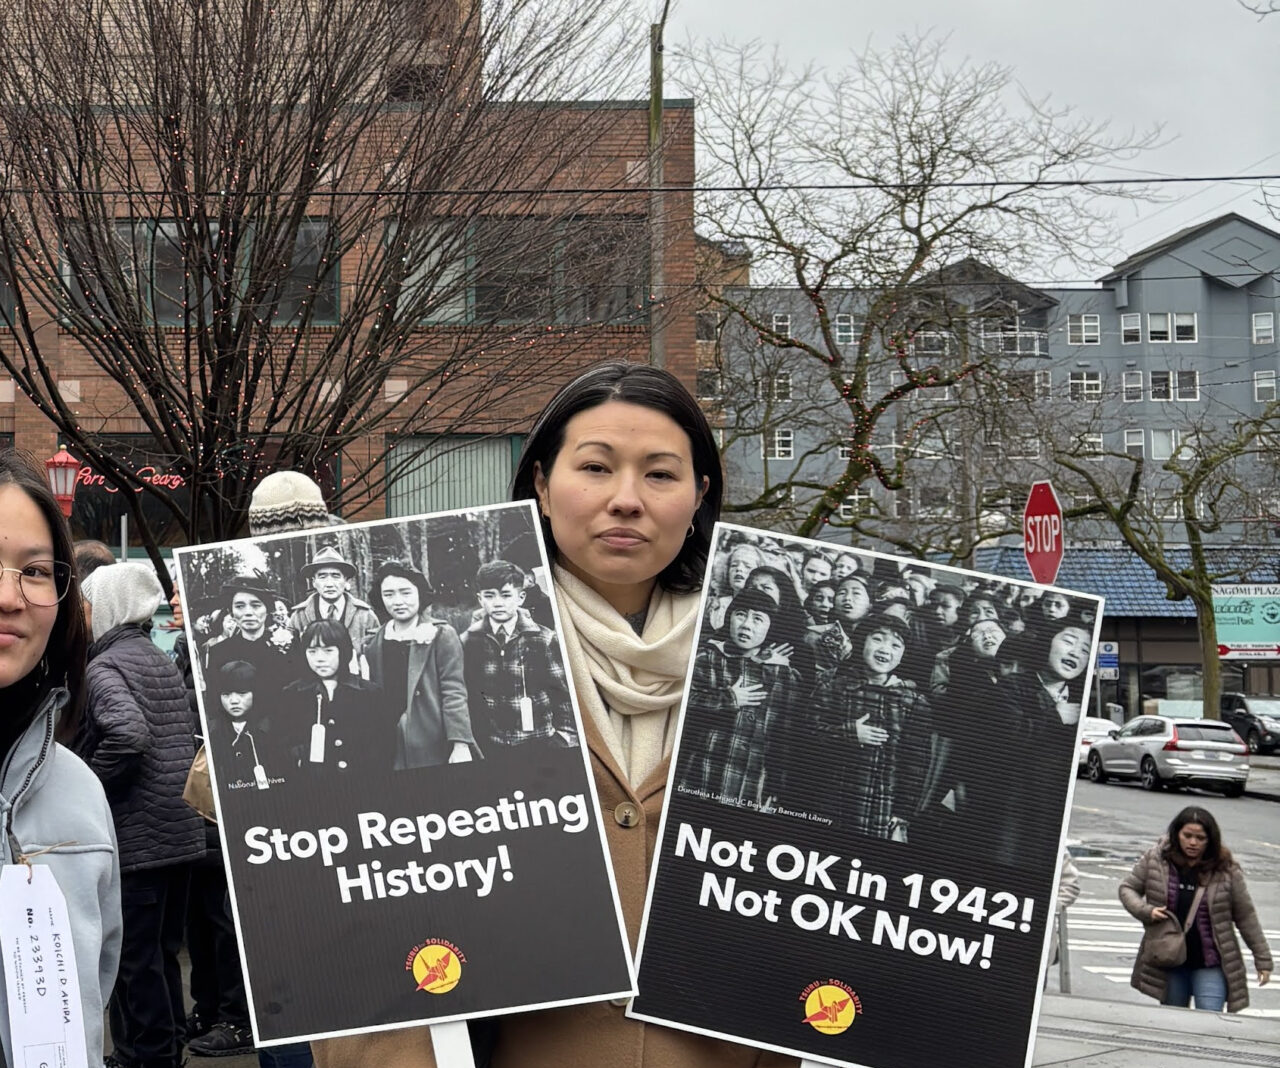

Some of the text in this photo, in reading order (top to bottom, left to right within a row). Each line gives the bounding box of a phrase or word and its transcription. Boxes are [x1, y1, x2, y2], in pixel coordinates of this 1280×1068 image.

[1027, 514, 1060, 553] STOP
[1212, 586, 1251, 596] NAGOMI
[677, 785, 710, 798] Dorothea
[778, 806, 808, 819] Bancroft
[808, 813, 833, 826] Library
[244, 790, 590, 867] Stop Repeating
[335, 844, 515, 904] History!
[674, 822, 1036, 934] Not OK in 1942!
[26, 908, 34, 929] No.
[698, 871, 996, 970] Not OK Now!
[51, 933, 65, 972] KOICHI
[405, 945, 420, 971] TSURU
[425, 937, 468, 963] SOLIDARITY
[798, 980, 820, 1001] TSURU
[828, 978, 864, 1015] SOLIDARITY
